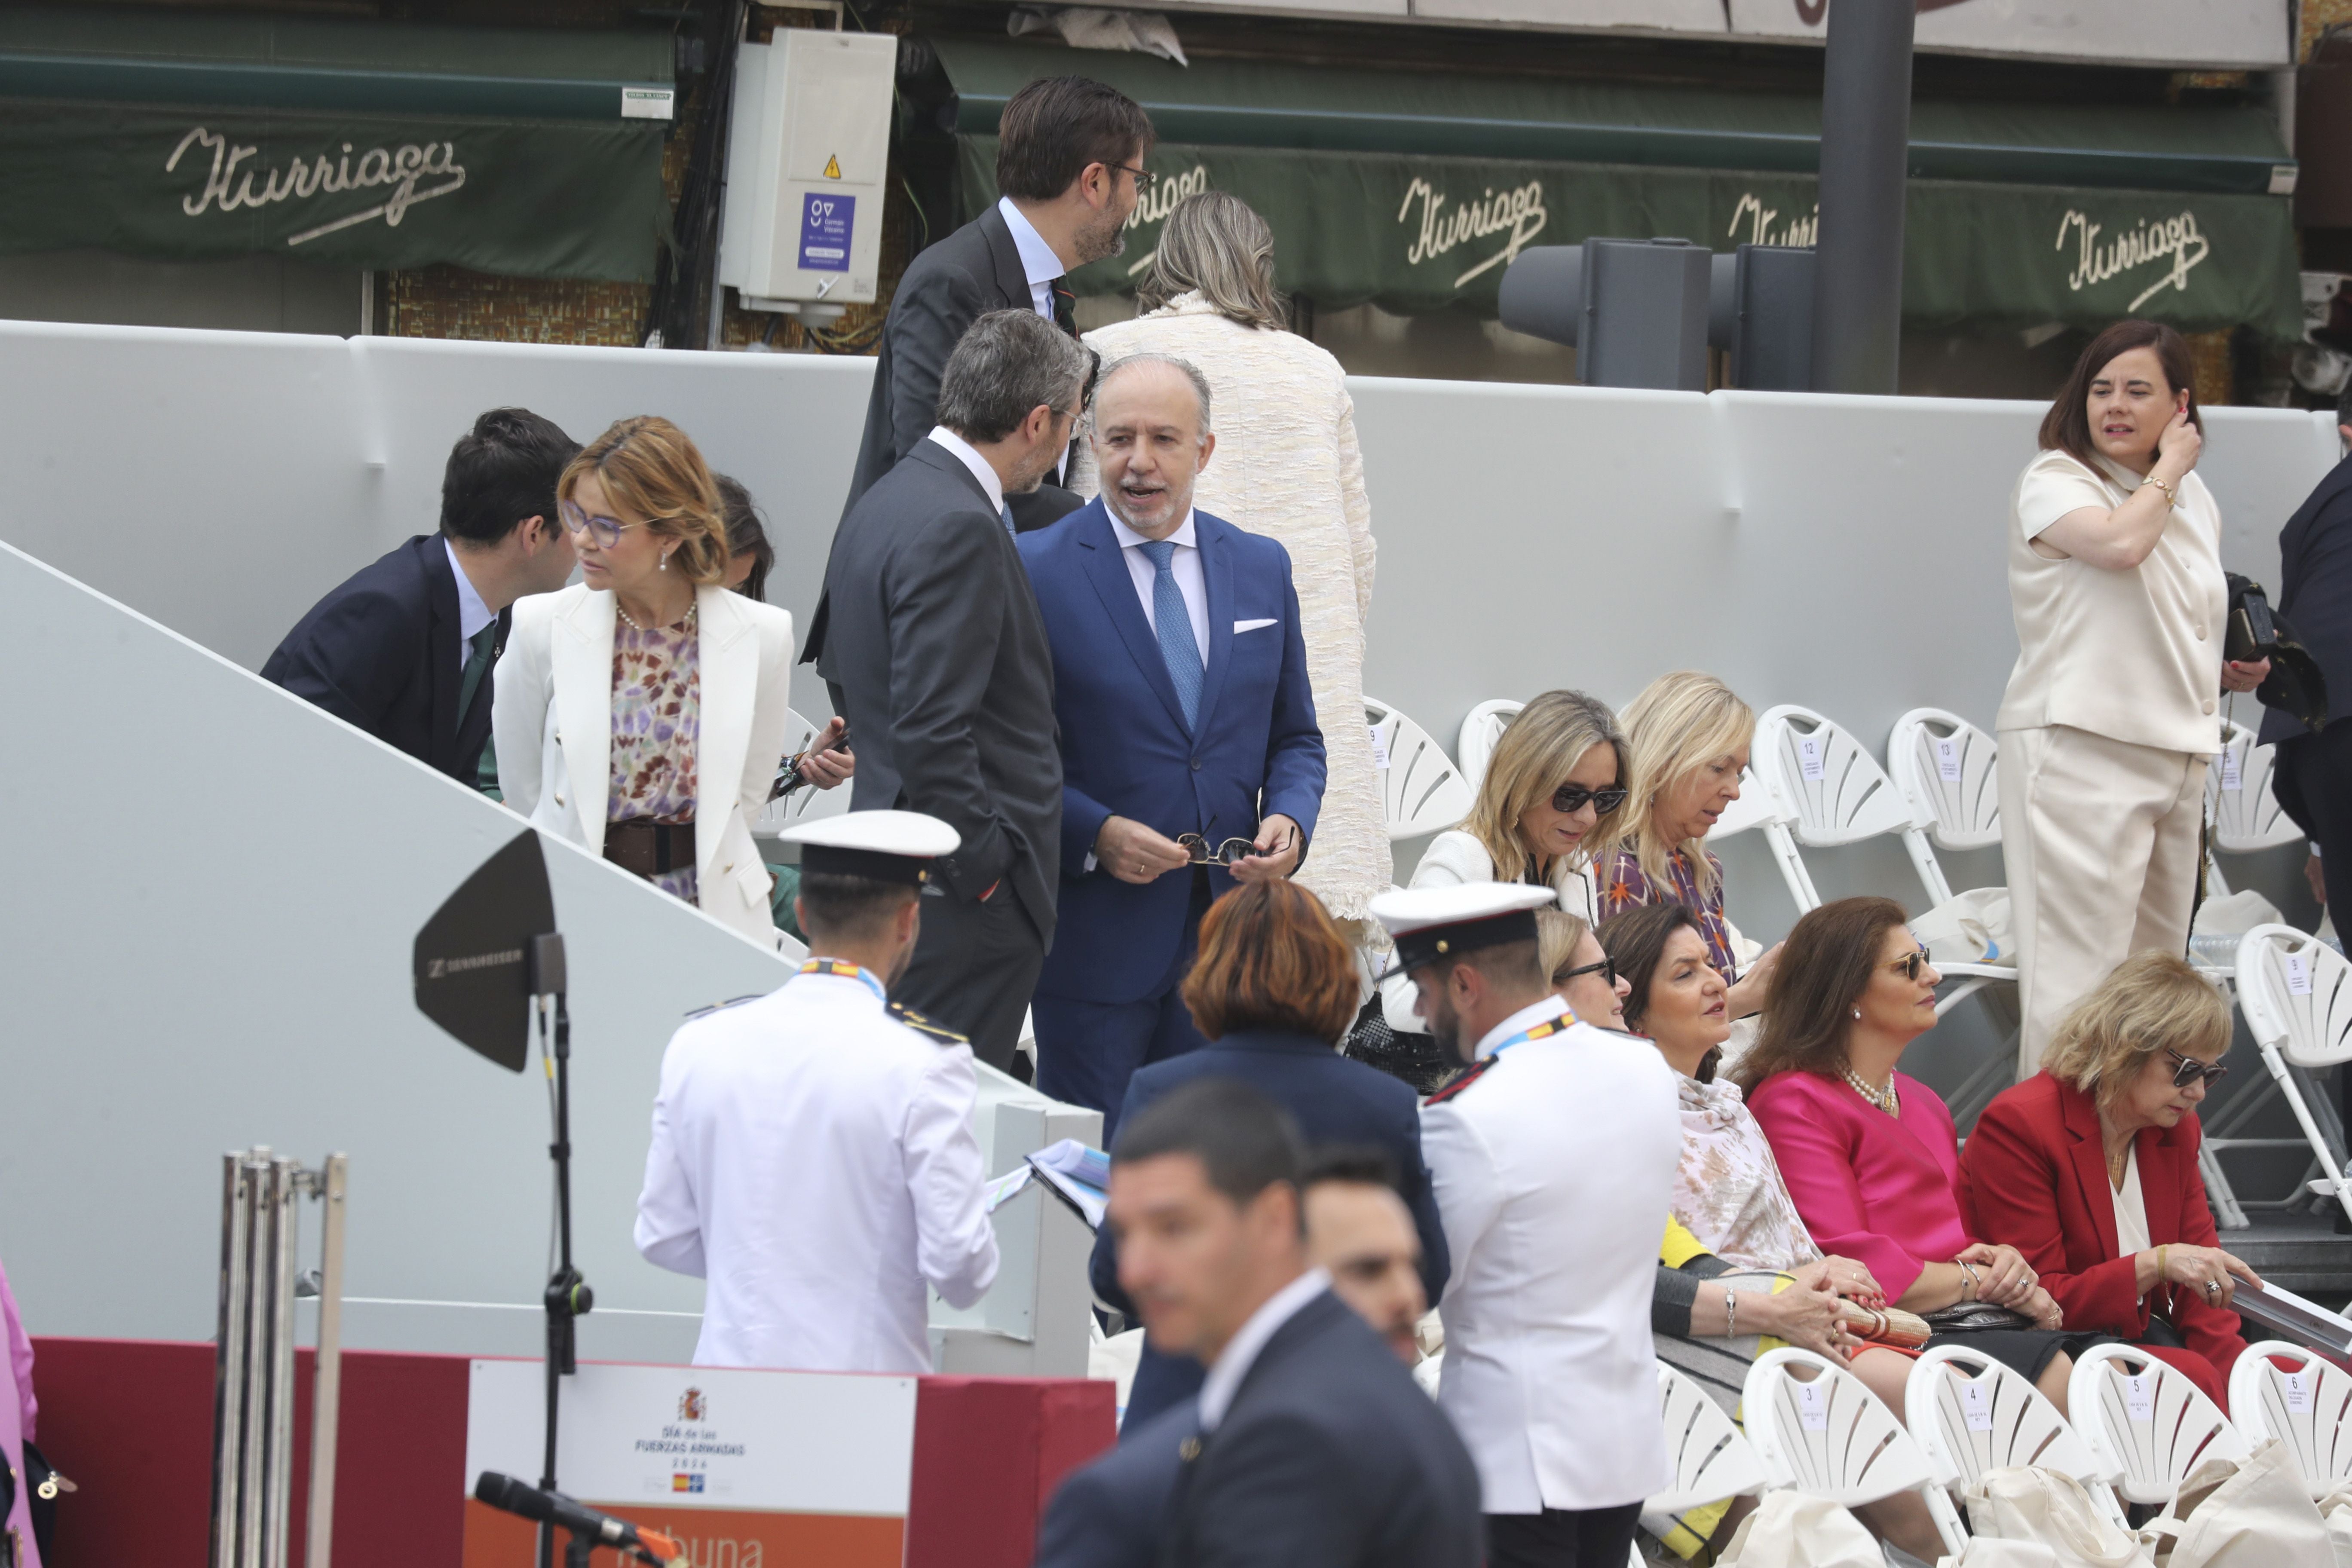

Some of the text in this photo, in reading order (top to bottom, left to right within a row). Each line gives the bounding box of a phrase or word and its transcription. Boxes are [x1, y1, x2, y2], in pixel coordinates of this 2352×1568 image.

[1370, 730, 1375, 741] 9
[1804, 743, 1813, 754] 12
[2133, 1379, 2140, 1393] 5
[2291, 1376, 2298, 1389] 6
[1806, 1387, 1812, 1401] 3
[1970, 1387, 1976, 1401] 4
[662, 1425, 717, 1440] DÍA de las
[634, 1440, 746, 1456] FUERZAS ARMADAS
